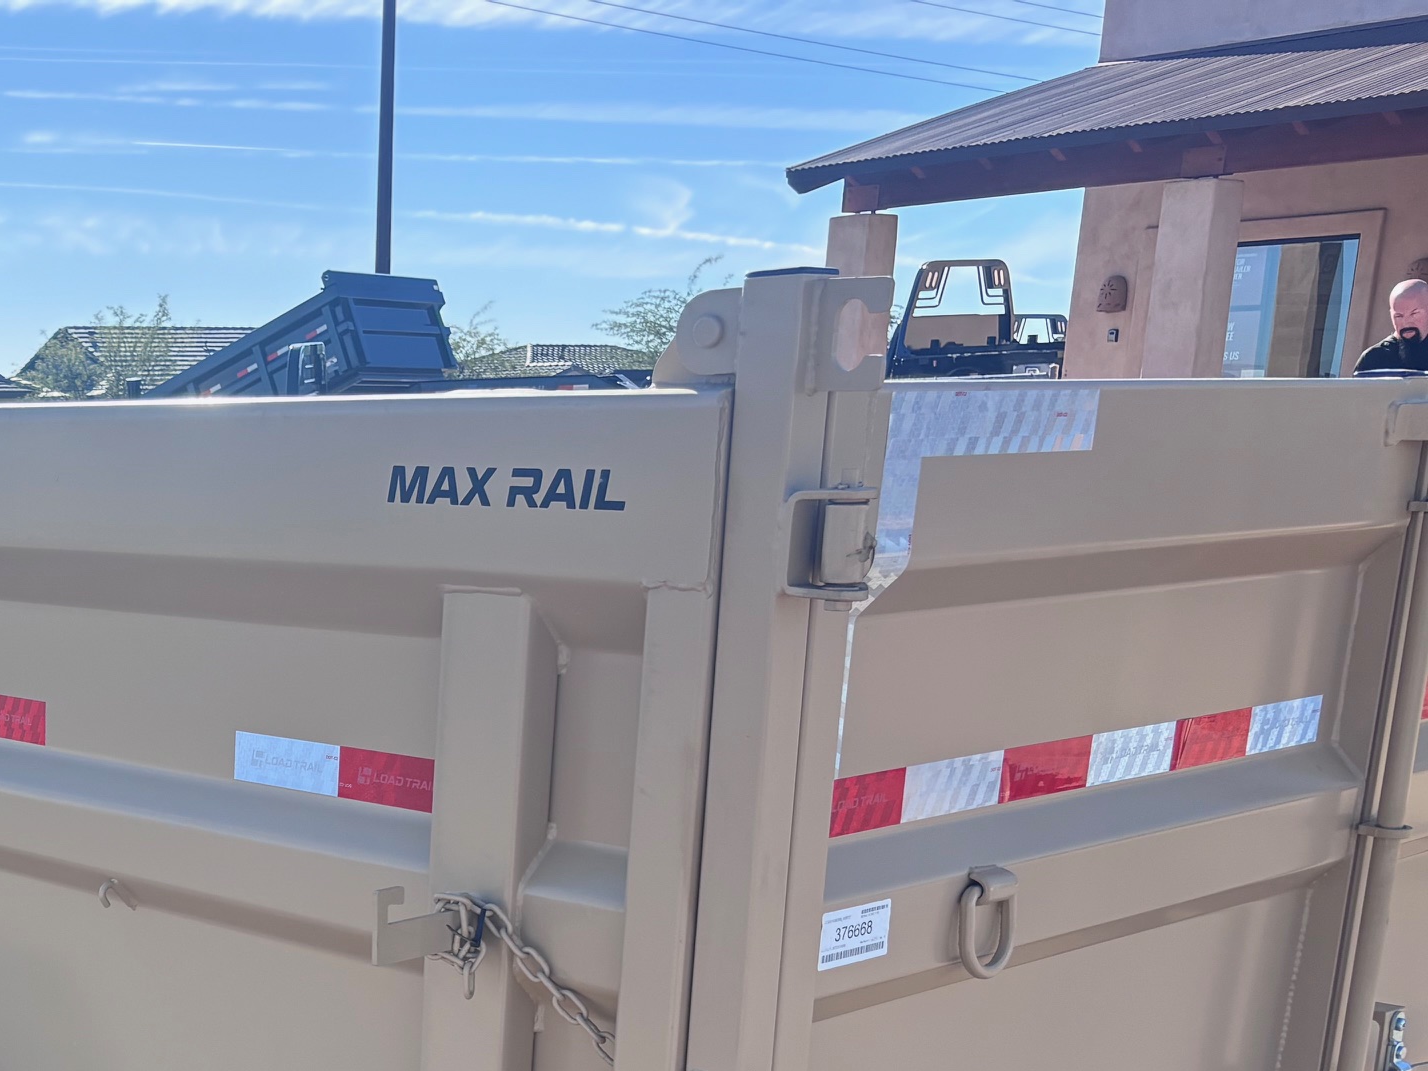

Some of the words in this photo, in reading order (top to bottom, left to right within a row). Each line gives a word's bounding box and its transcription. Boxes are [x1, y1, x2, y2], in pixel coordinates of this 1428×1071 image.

[387, 465, 497, 507] MAX
[506, 468, 626, 511] RAIL
[373, 773, 404, 786] LOAD
[835, 920, 873, 942] 376668
